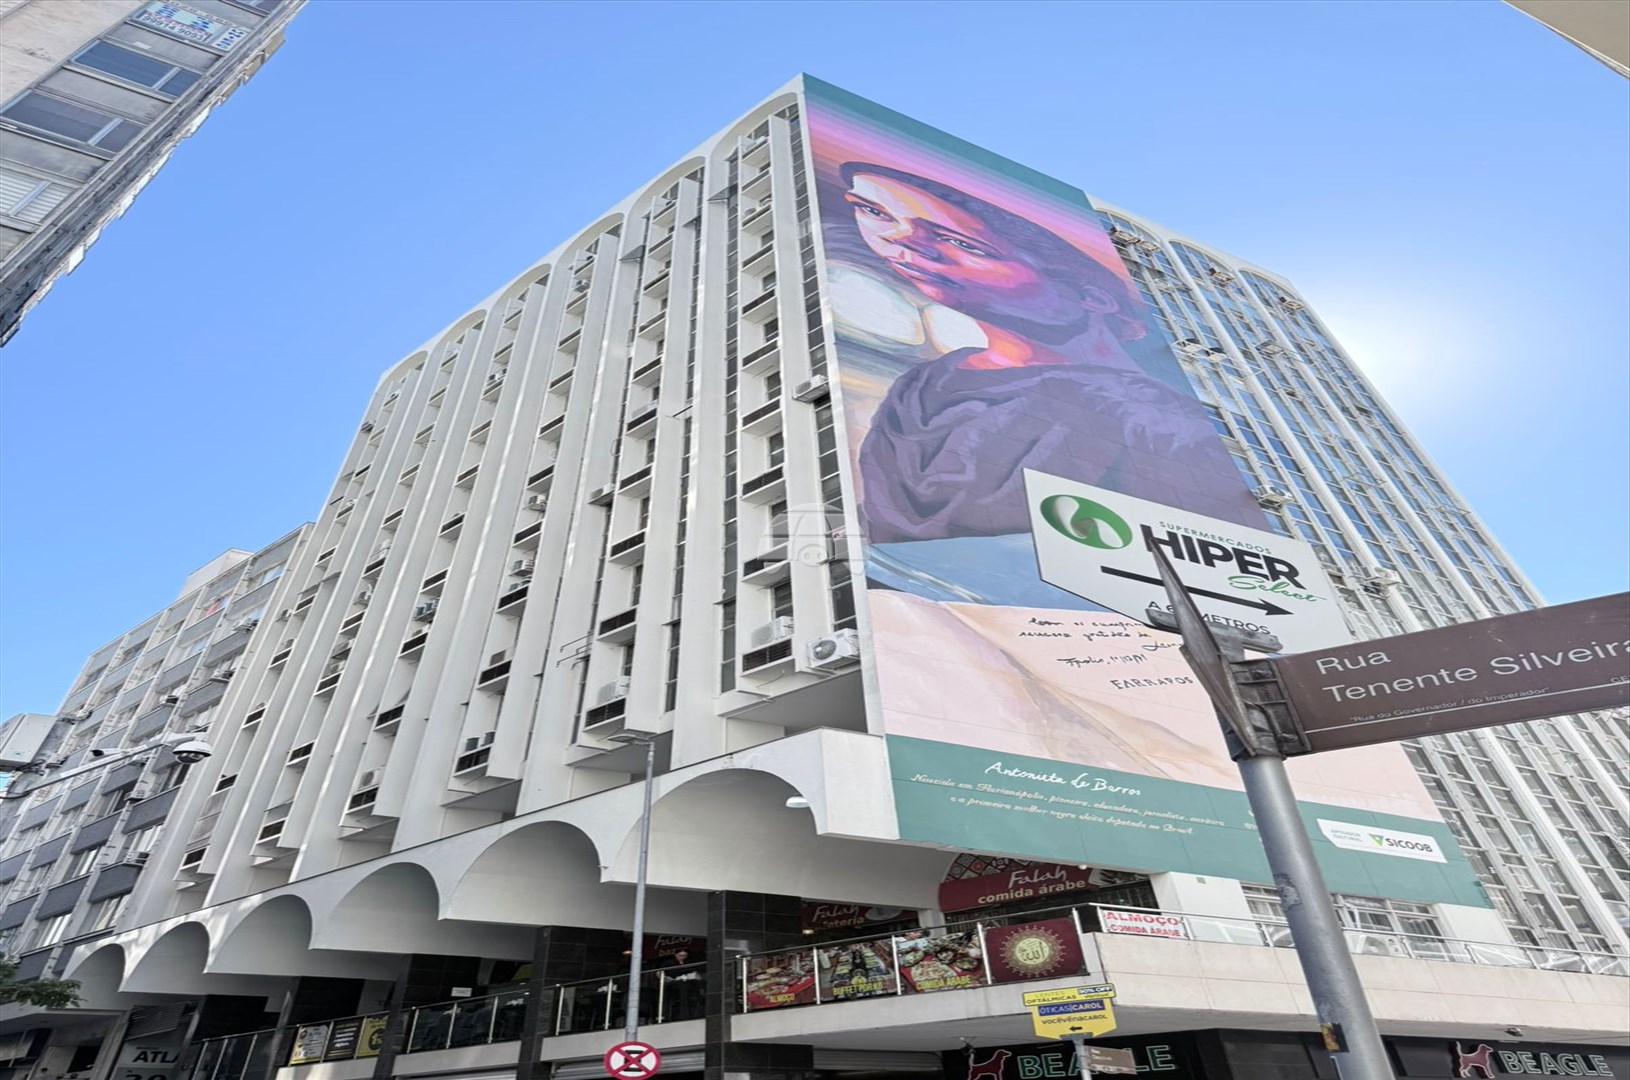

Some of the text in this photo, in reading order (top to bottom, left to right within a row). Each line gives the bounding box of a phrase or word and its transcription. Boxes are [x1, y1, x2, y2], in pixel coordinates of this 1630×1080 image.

[1159, 521, 1272, 555] SUPERMERCADOS
[1139, 523, 1307, 590] HIPER
[1227, 575, 1327, 602] Select
[1200, 612, 1271, 635] METROS
[1315, 651, 1391, 675] Rua
[1322, 667, 1478, 702] Tenente
[1377, 711, 1391, 719] do
[1393, 700, 1458, 715] Governador
[984, 761, 1142, 797] Antonieta de Barros
[1384, 838, 1433, 853] SICOOB
[1008, 865, 1068, 889] Falah
[977, 878, 1087, 904] comida árabe
[812, 904, 859, 922] Falah
[1106, 912, 1179, 926] ALMOÇO
[1110, 924, 1148, 933] COMIDA
[832, 984, 857, 996] BUFFET
[1072, 1002, 1103, 1011] CAROL
[1498, 1051, 1614, 1077] BEAGLE
